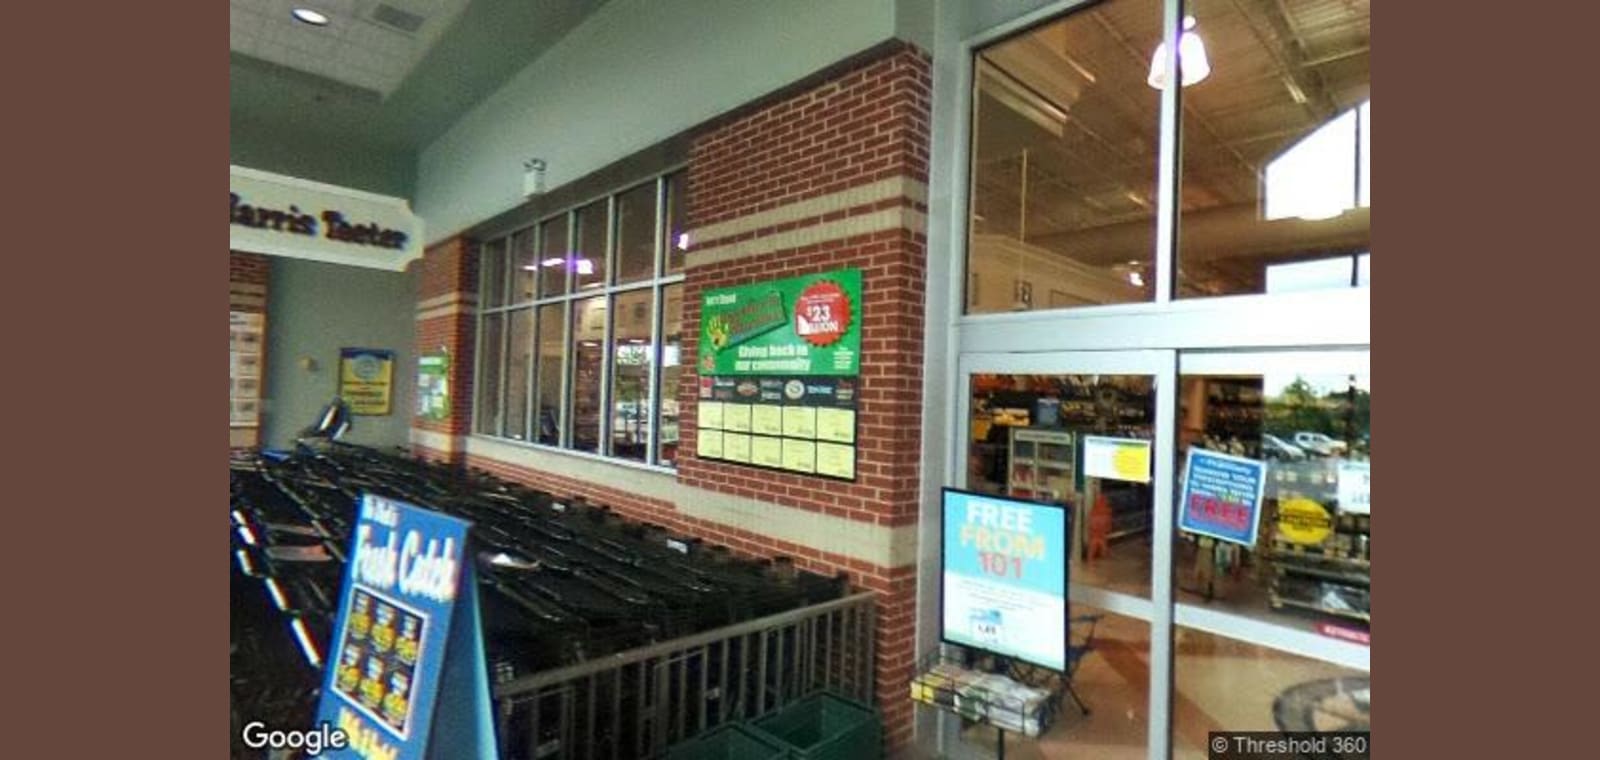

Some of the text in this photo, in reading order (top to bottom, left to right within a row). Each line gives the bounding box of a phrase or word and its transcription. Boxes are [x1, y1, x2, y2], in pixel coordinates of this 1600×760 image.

[807, 303, 831, 322] $23
[769, 344, 795, 357] back
[966, 501, 1034, 534] FREE
[1190, 493, 1252, 531] FREE
[960, 523, 1046, 561] FROM
[399, 529, 457, 602] Catch
[979, 550, 1025, 579] 101
